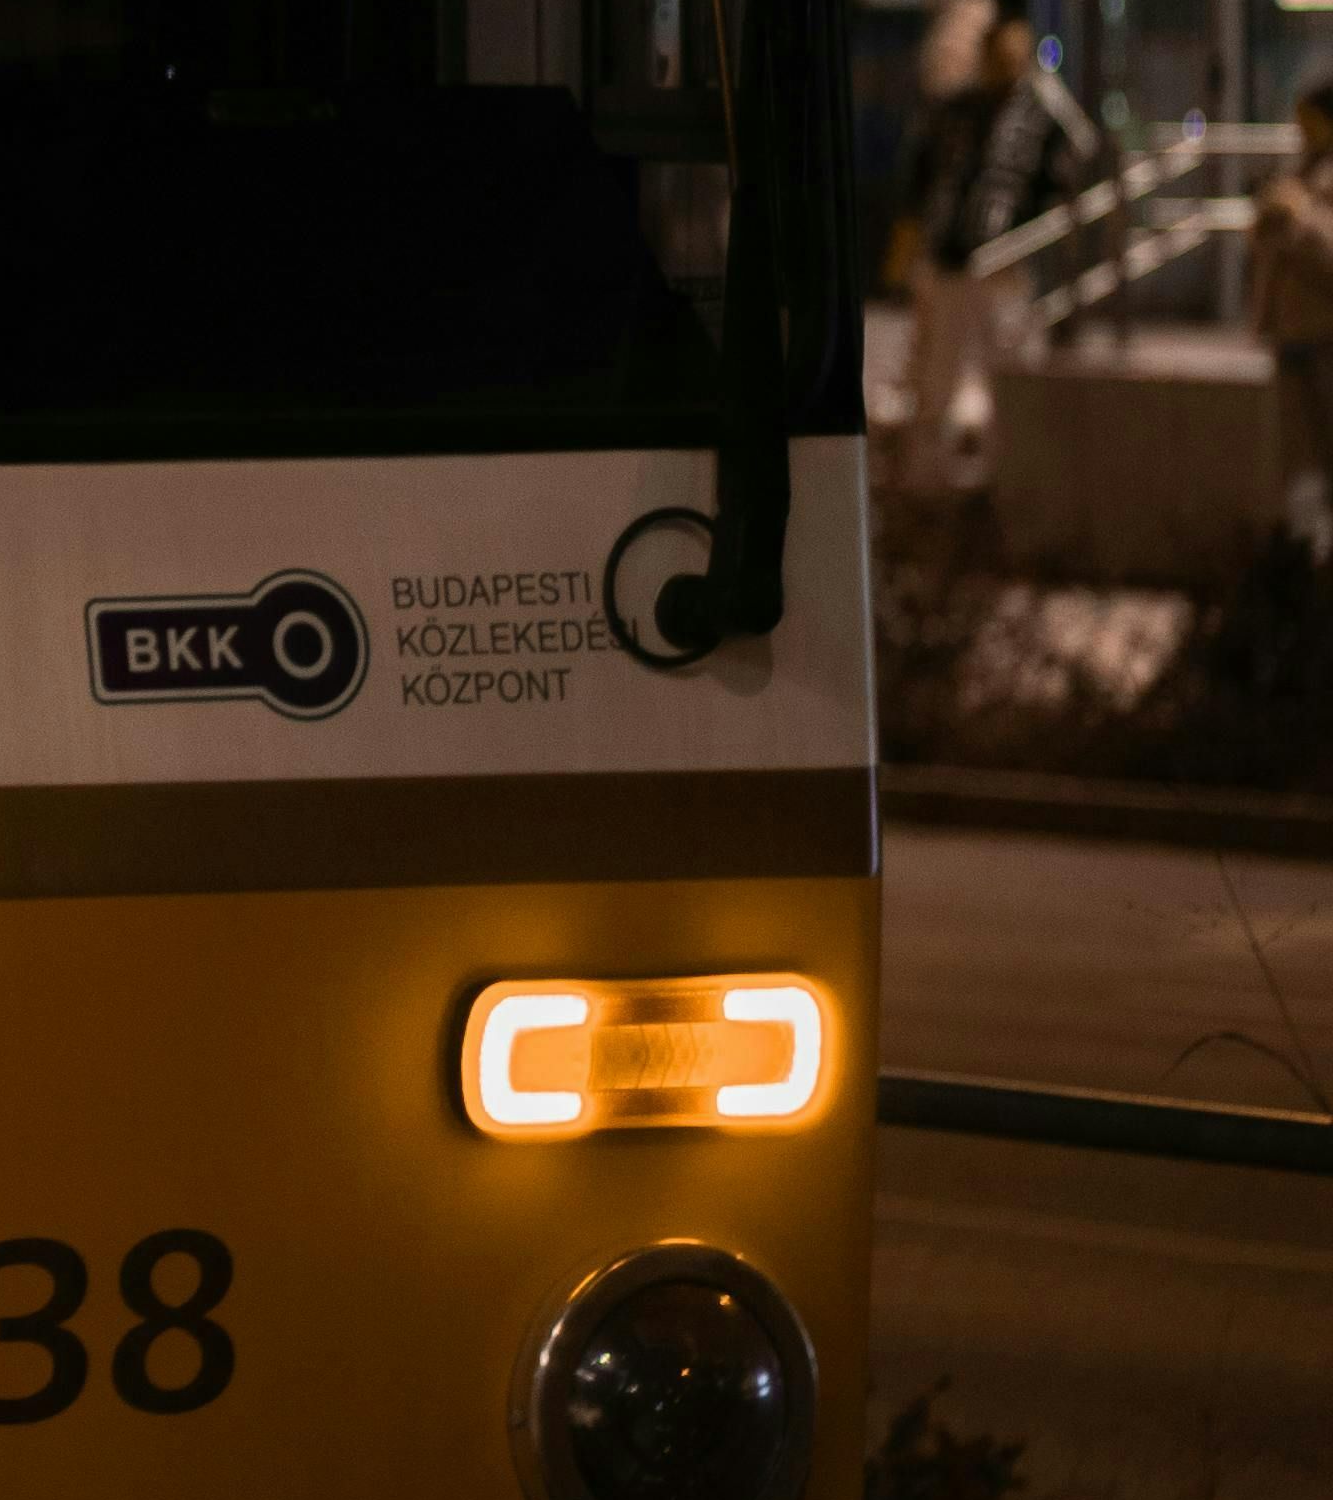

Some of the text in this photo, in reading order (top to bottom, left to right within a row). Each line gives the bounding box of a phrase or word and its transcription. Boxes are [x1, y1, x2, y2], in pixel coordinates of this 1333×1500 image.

[391, 571, 592, 609] BUDAPESTI
[125, 626, 243, 674] BKK
[400, 664, 572, 706] KÖZPONT
